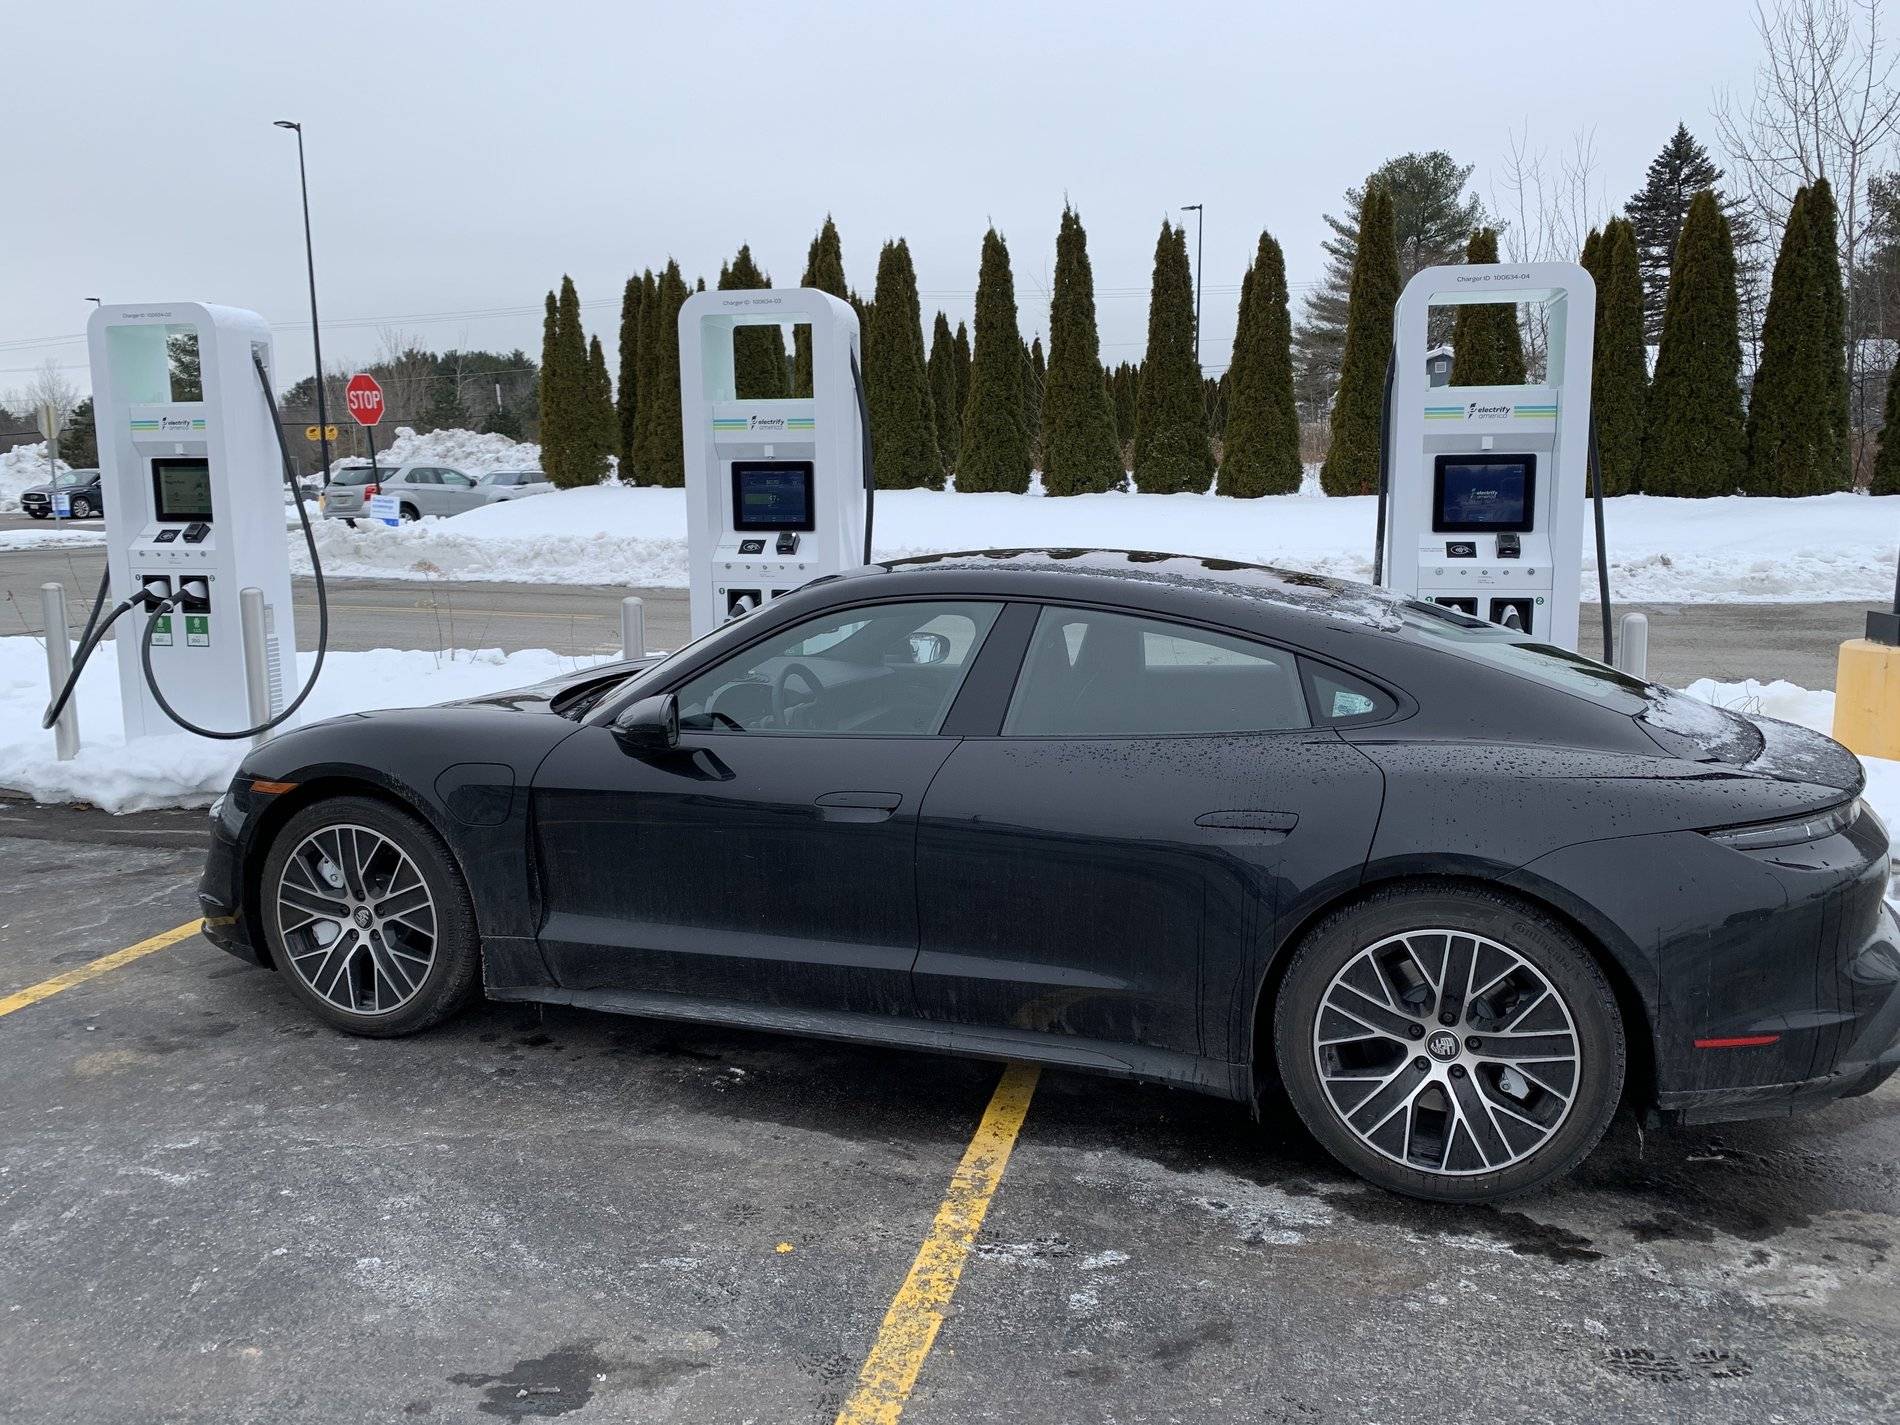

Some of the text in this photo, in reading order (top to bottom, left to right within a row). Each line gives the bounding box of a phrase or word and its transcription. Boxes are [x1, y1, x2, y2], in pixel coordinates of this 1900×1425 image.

[1456, 275, 1482, 283] Charger
[1493, 273, 1530, 281] 100634-04
[350, 390, 380, 409] STOP
[1477, 406, 1511, 414] electrify
[758, 418, 785, 426] electrify
